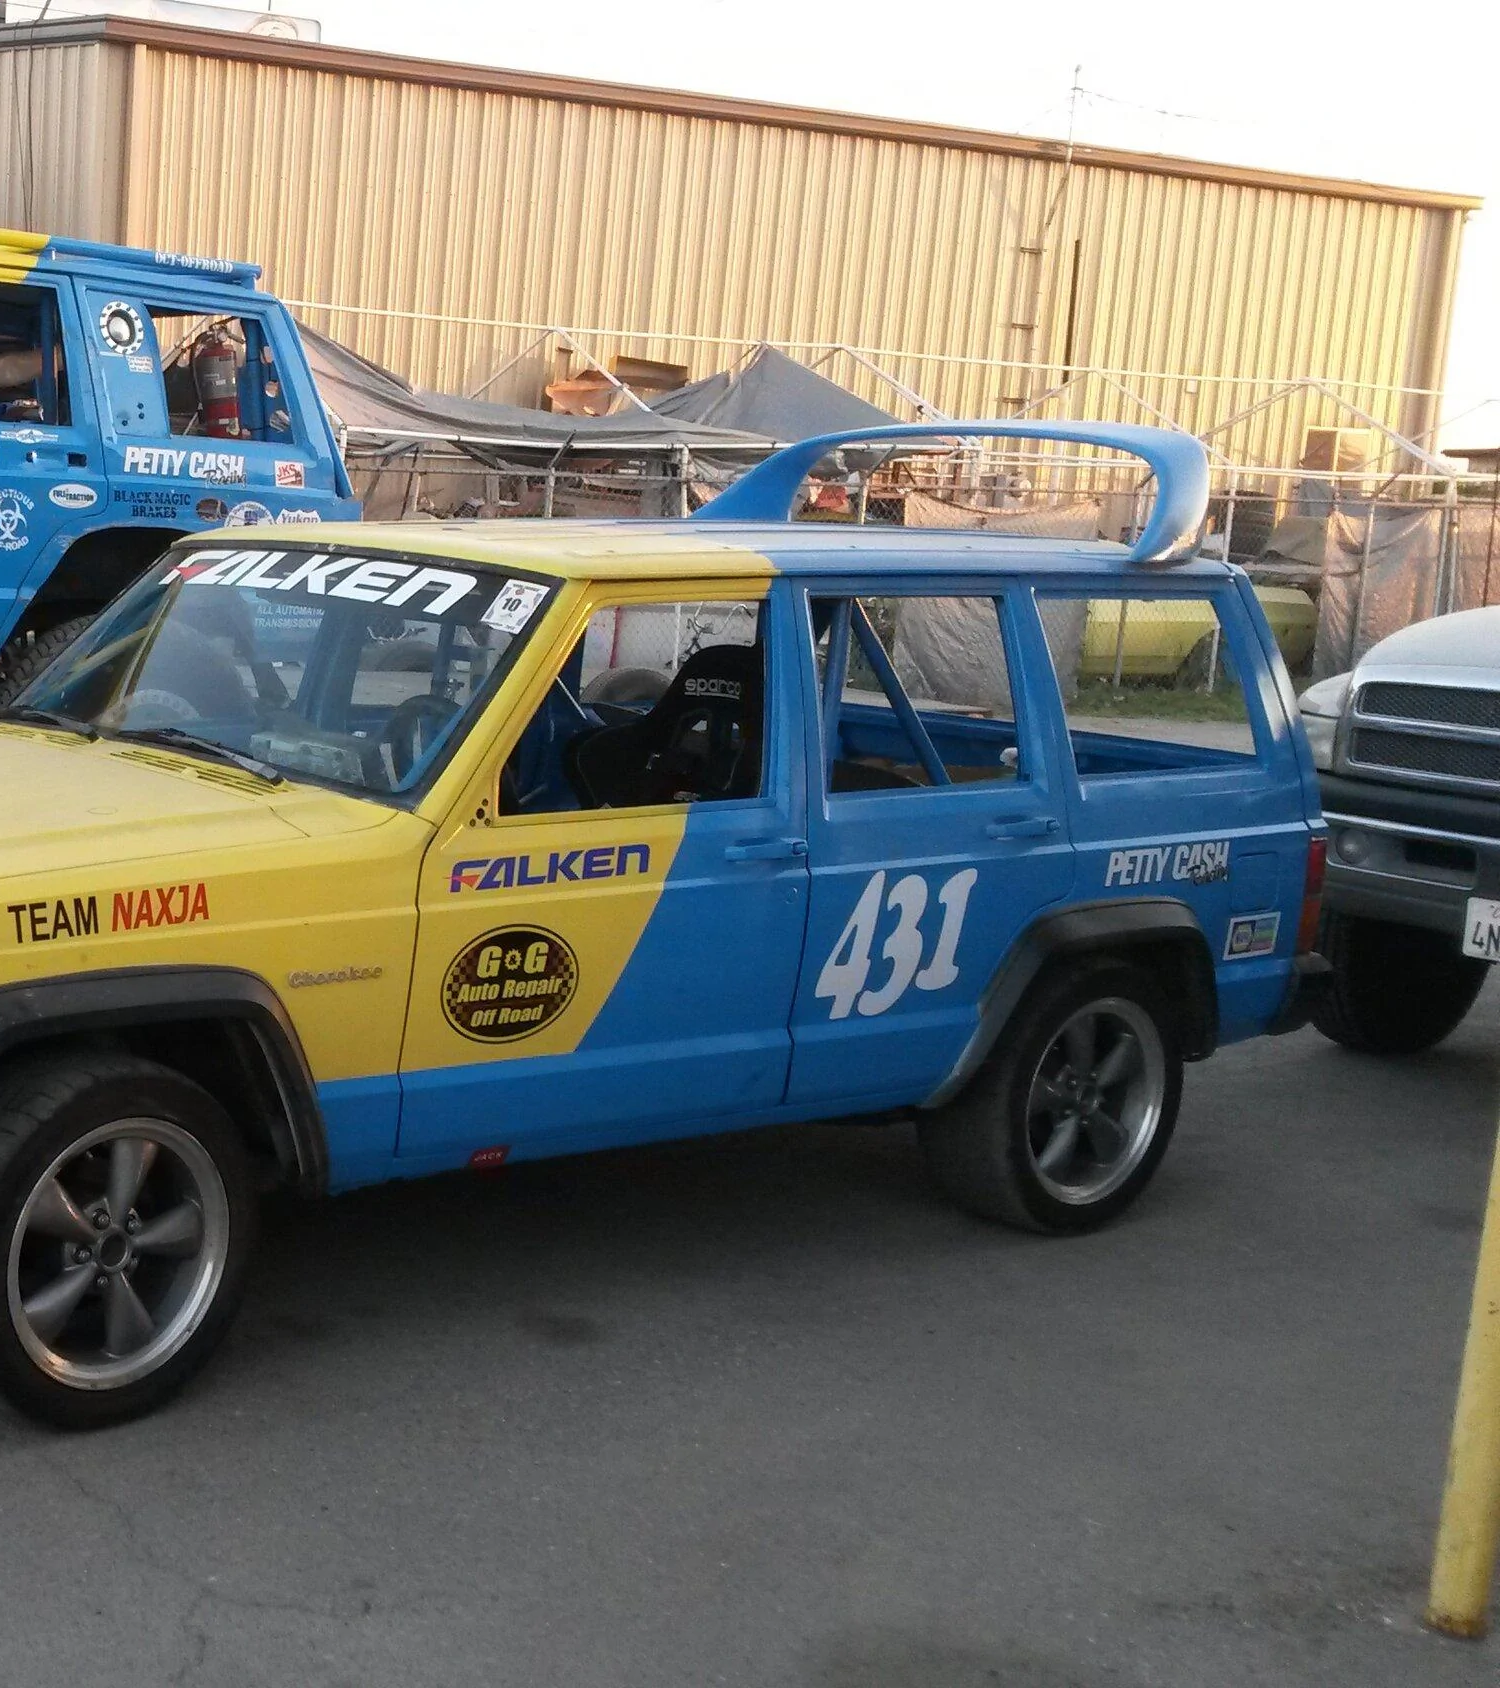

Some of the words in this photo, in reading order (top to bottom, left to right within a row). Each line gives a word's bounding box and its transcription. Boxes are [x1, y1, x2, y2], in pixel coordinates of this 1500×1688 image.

[123, 446, 187, 476] PETTY
[188, 452, 245, 479] CASH
[203, 469, 247, 488] Racing
[114, 490, 153, 503] BLACK
[154, 493, 191, 506] MAGIC
[132, 505, 177, 519] BRAKES
[158, 550, 477, 615] FALKEN
[257, 605, 273, 615] ALL
[502, 597, 522, 612] 10
[684, 678, 741, 697] sparco
[448, 843, 650, 892] FALKEN
[1104, 846, 1172, 887] PETTY
[1172, 841, 1230, 882] CASH
[7, 896, 99, 944] TEAM
[112, 883, 210, 932] NAXJA
[815, 867, 978, 1020] 431
[288, 965, 383, 989] Cherokee
[456, 983, 500, 1003] Auto
[502, 975, 563, 999] Repair
[470, 1009, 498, 1027] Off
[498, 1004, 544, 1024] Road
